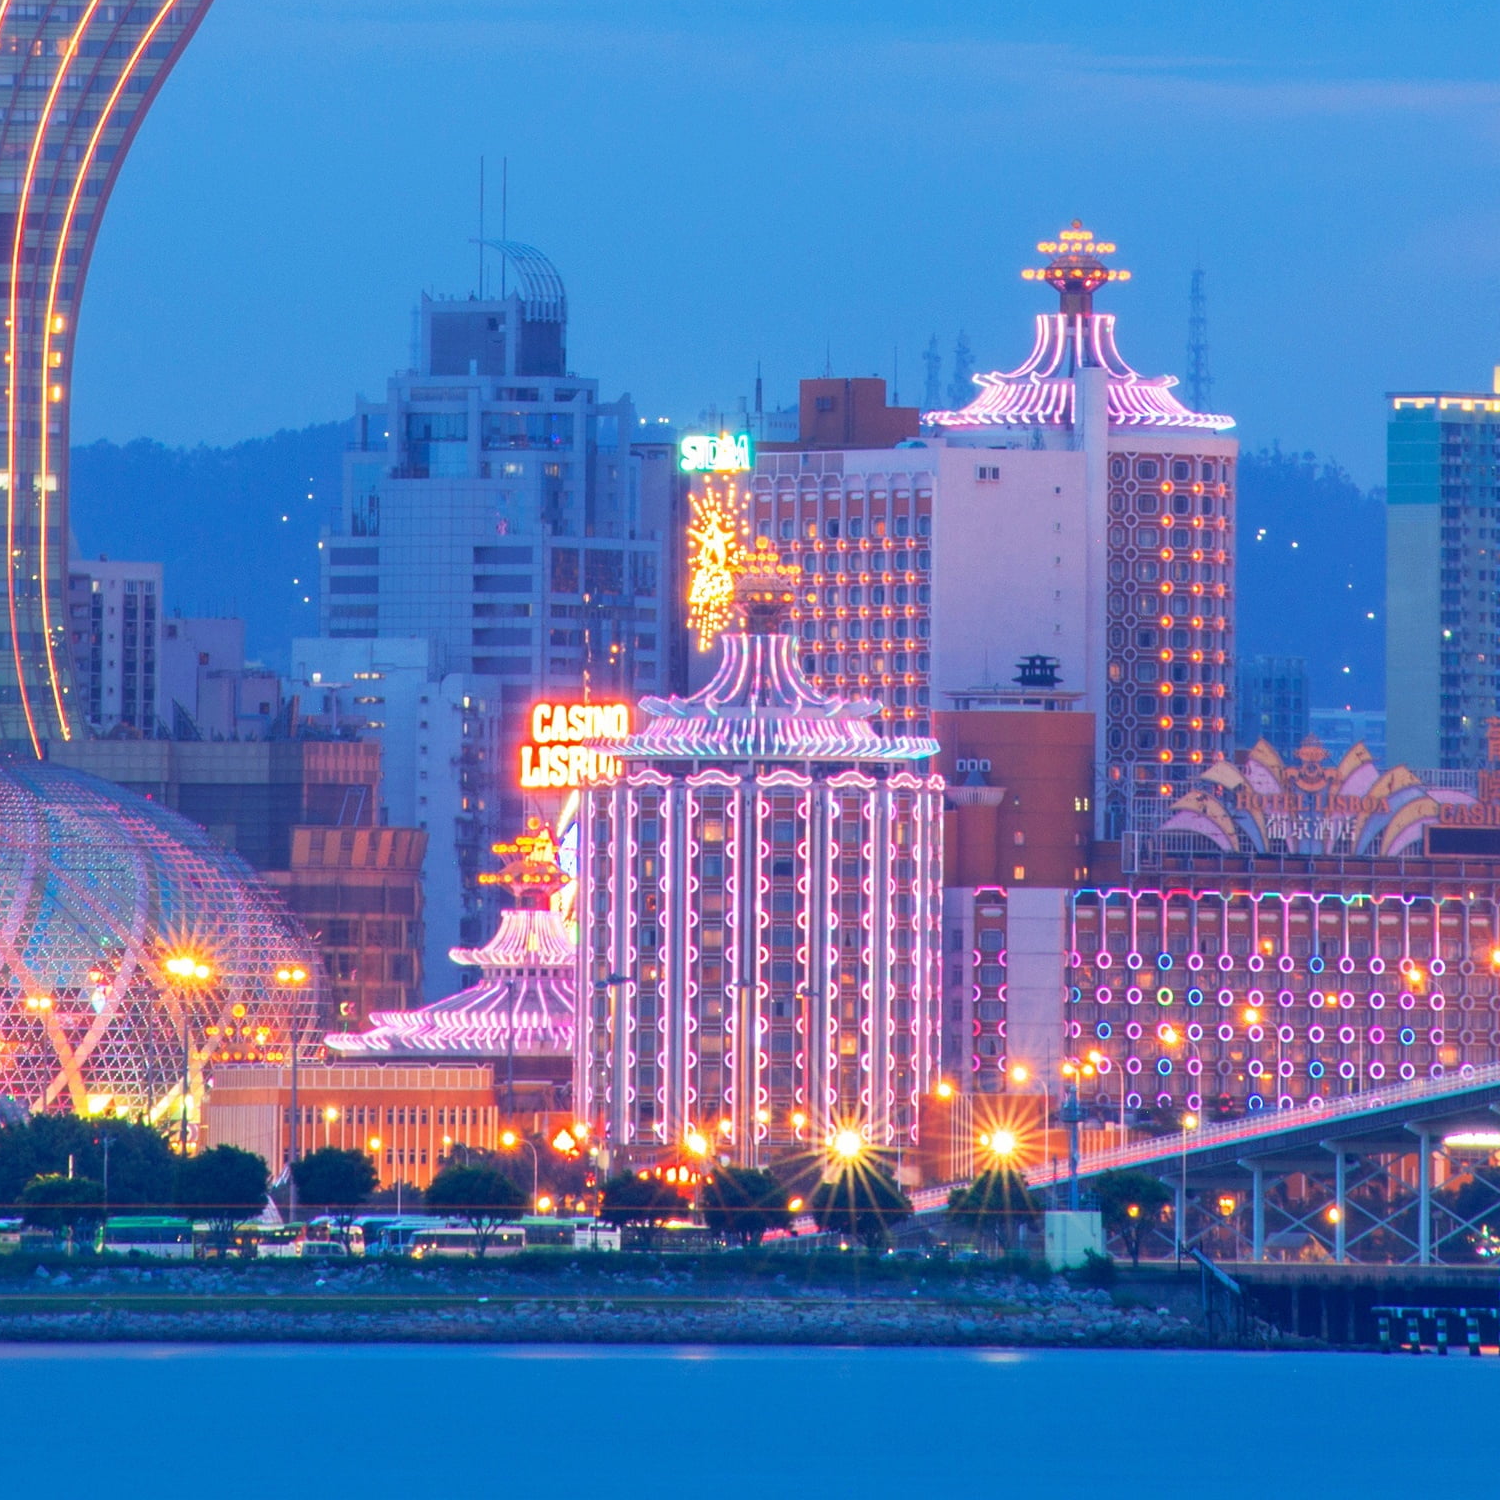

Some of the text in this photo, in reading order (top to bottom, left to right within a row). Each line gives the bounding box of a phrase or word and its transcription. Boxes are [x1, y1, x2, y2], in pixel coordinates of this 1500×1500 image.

[532, 703, 629, 743] CASINO
[1236, 792, 1391, 814] HOTEL LISBOA
[1266, 812, 1357, 842] 葡京酒店
